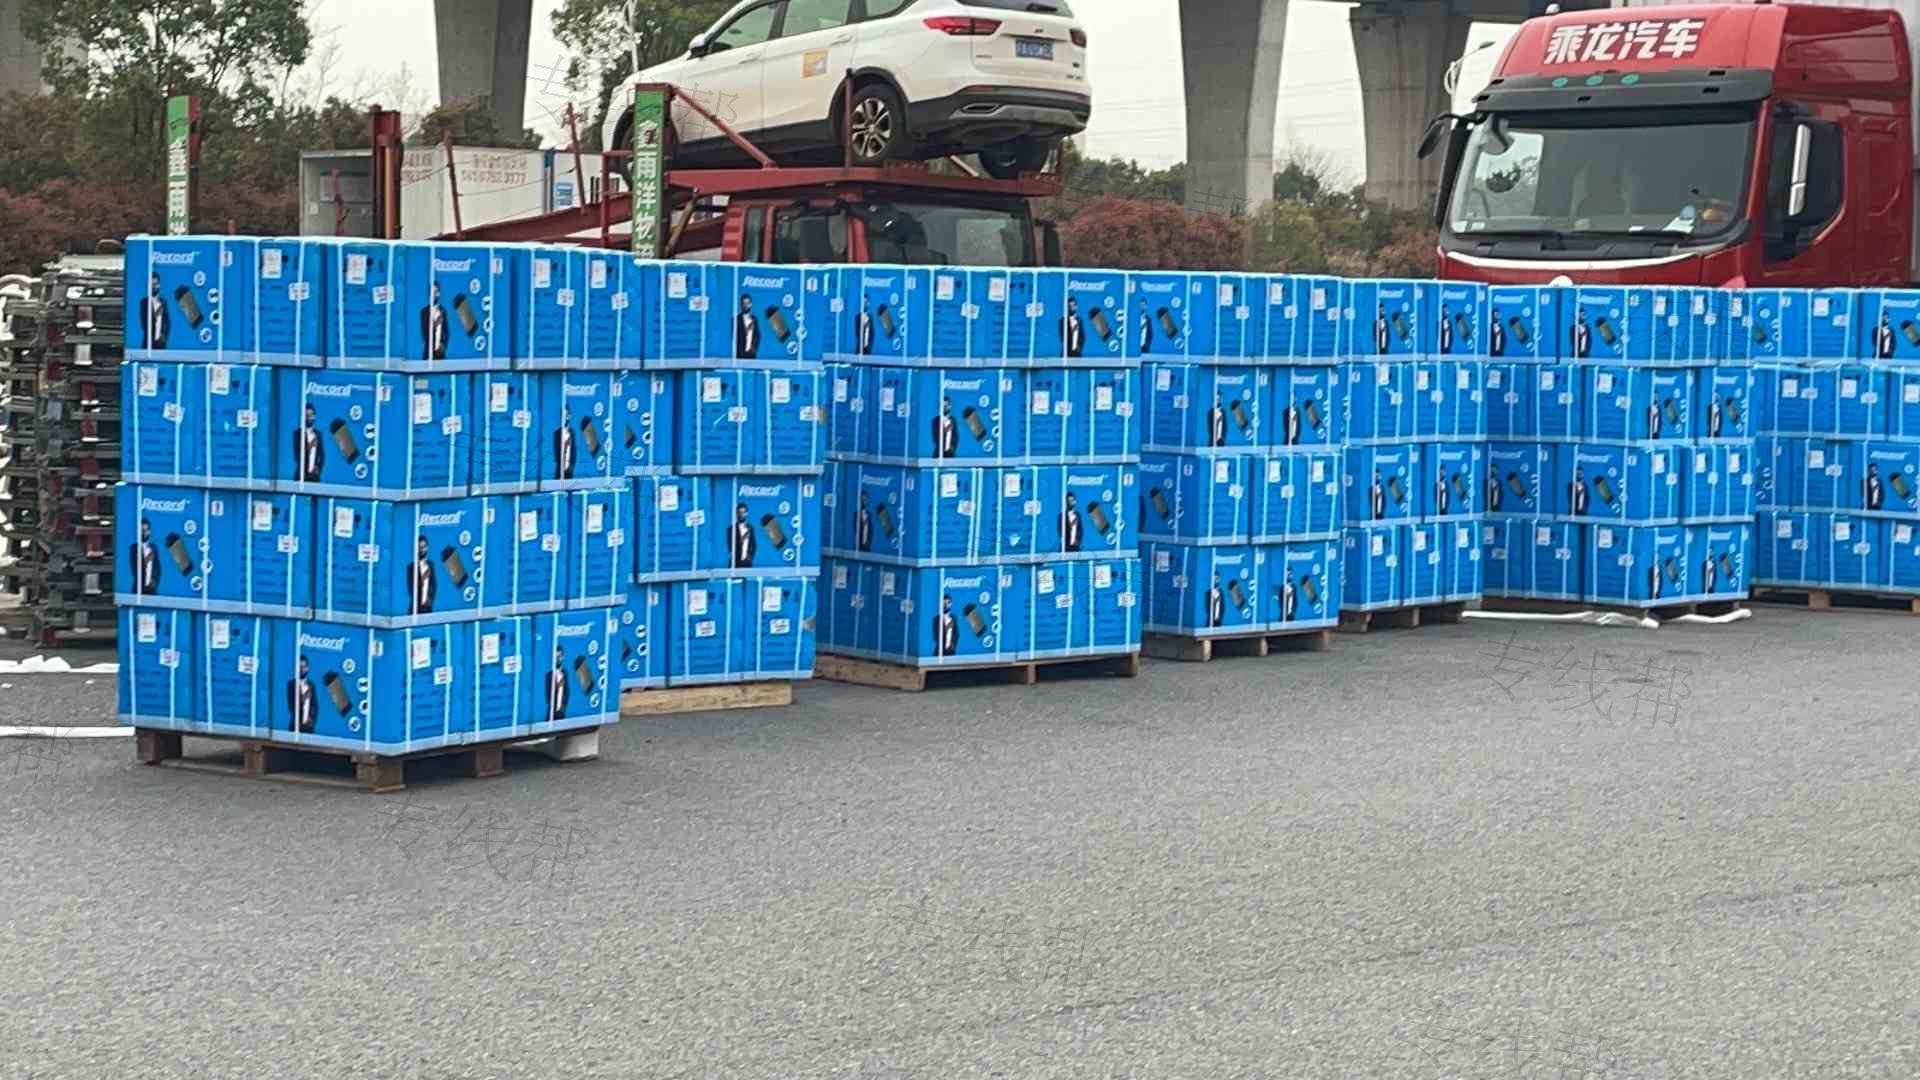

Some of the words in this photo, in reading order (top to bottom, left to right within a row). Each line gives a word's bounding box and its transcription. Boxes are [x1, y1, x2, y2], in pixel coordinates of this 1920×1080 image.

[1543, 18, 1704, 65] 乘龙汽车
[141, 497, 187, 512] Record
[299, 633, 346, 650] Record
